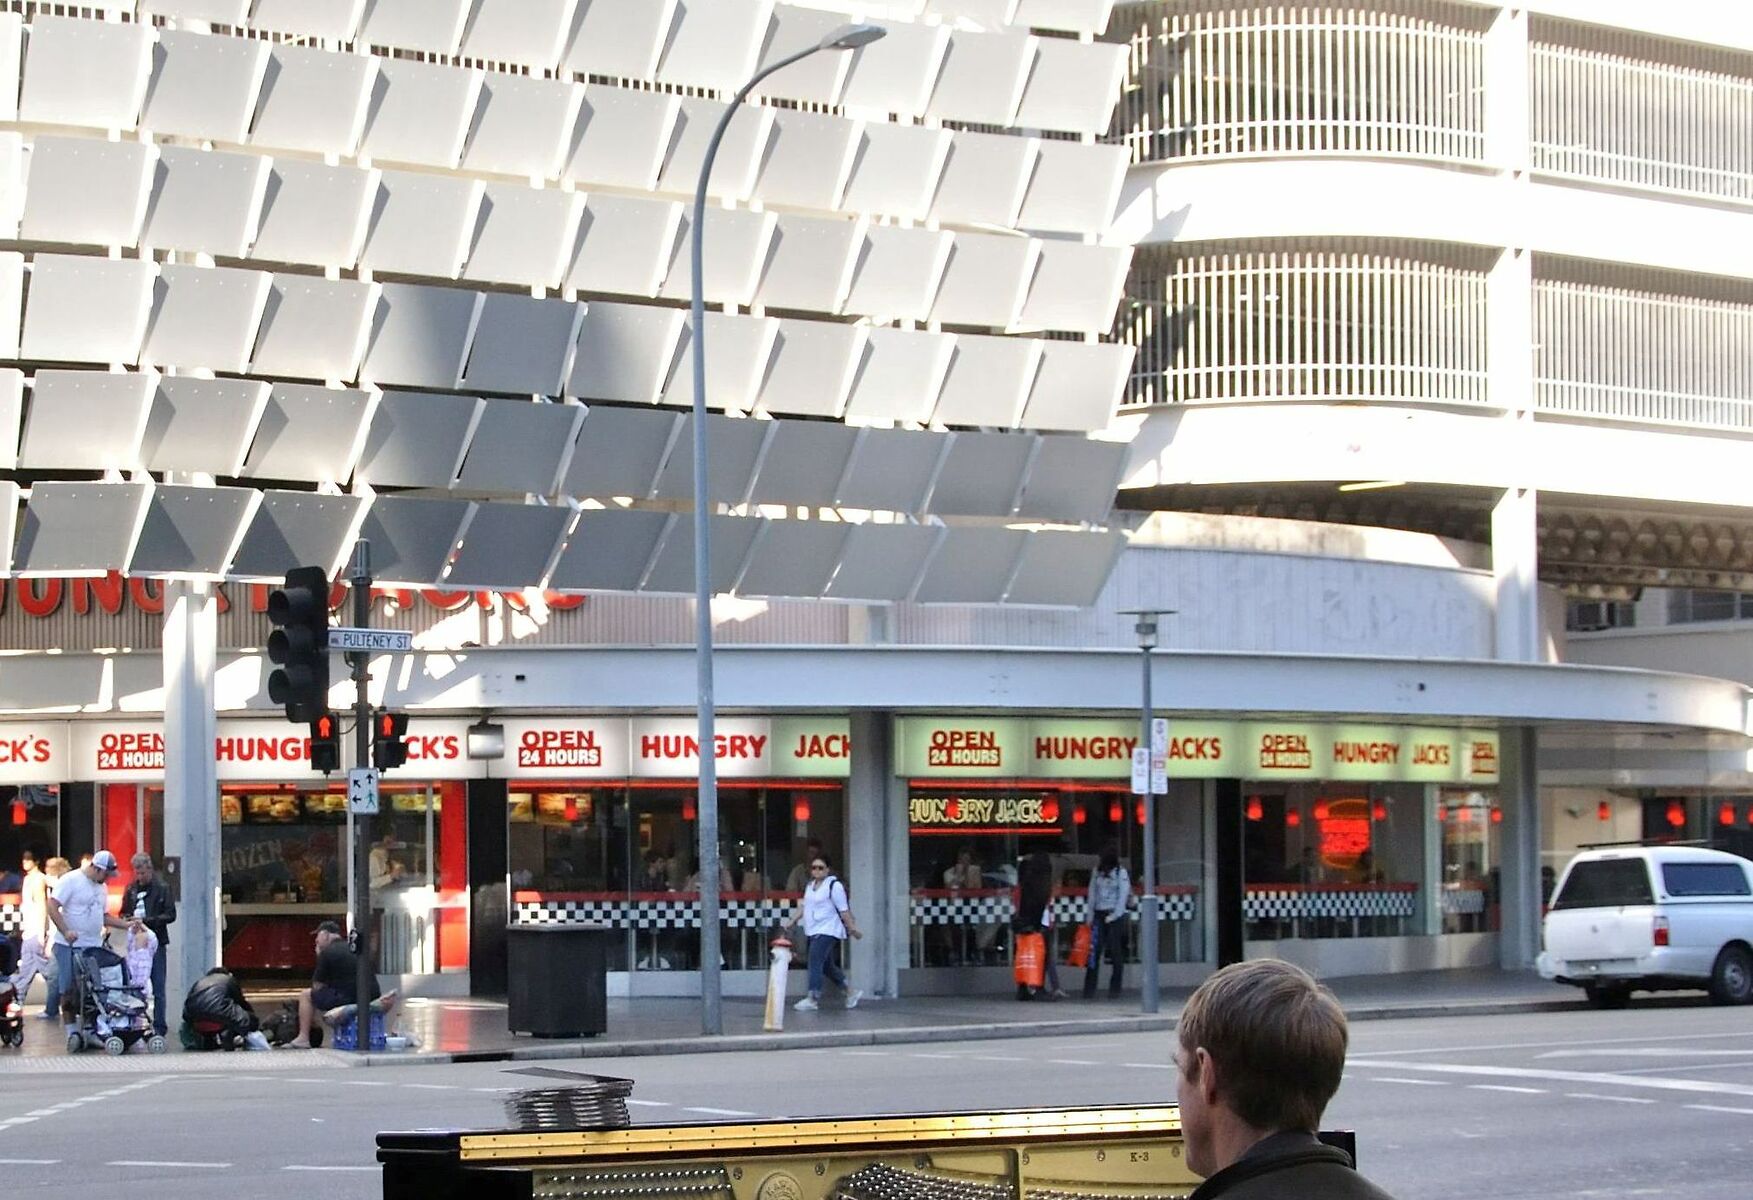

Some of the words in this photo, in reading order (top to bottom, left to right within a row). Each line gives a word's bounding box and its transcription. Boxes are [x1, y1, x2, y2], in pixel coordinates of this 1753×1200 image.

[343, 632, 392, 649] PULTENEY
[396, 636, 408, 649] ST
[216, 737, 311, 761] HUNG
[405, 735, 459, 760] CK'S
[521, 731, 594, 748] OPEN
[641, 735, 766, 759] HUNGRY
[932, 731, 994, 748] OPEN
[1035, 736, 1138, 760] HUNGRY
[1169, 737, 1221, 760] ACK'S
[1263, 734, 1306, 750] OPEN
[100, 751, 118, 768] 24
[123, 752, 164, 768] HOUR
[521, 750, 540, 765] 24
[545, 749, 599, 765] HOURS
[930, 749, 948, 764] 24
[952, 749, 998, 764] HOURS
[1334, 742, 1399, 764] HUNGRY
